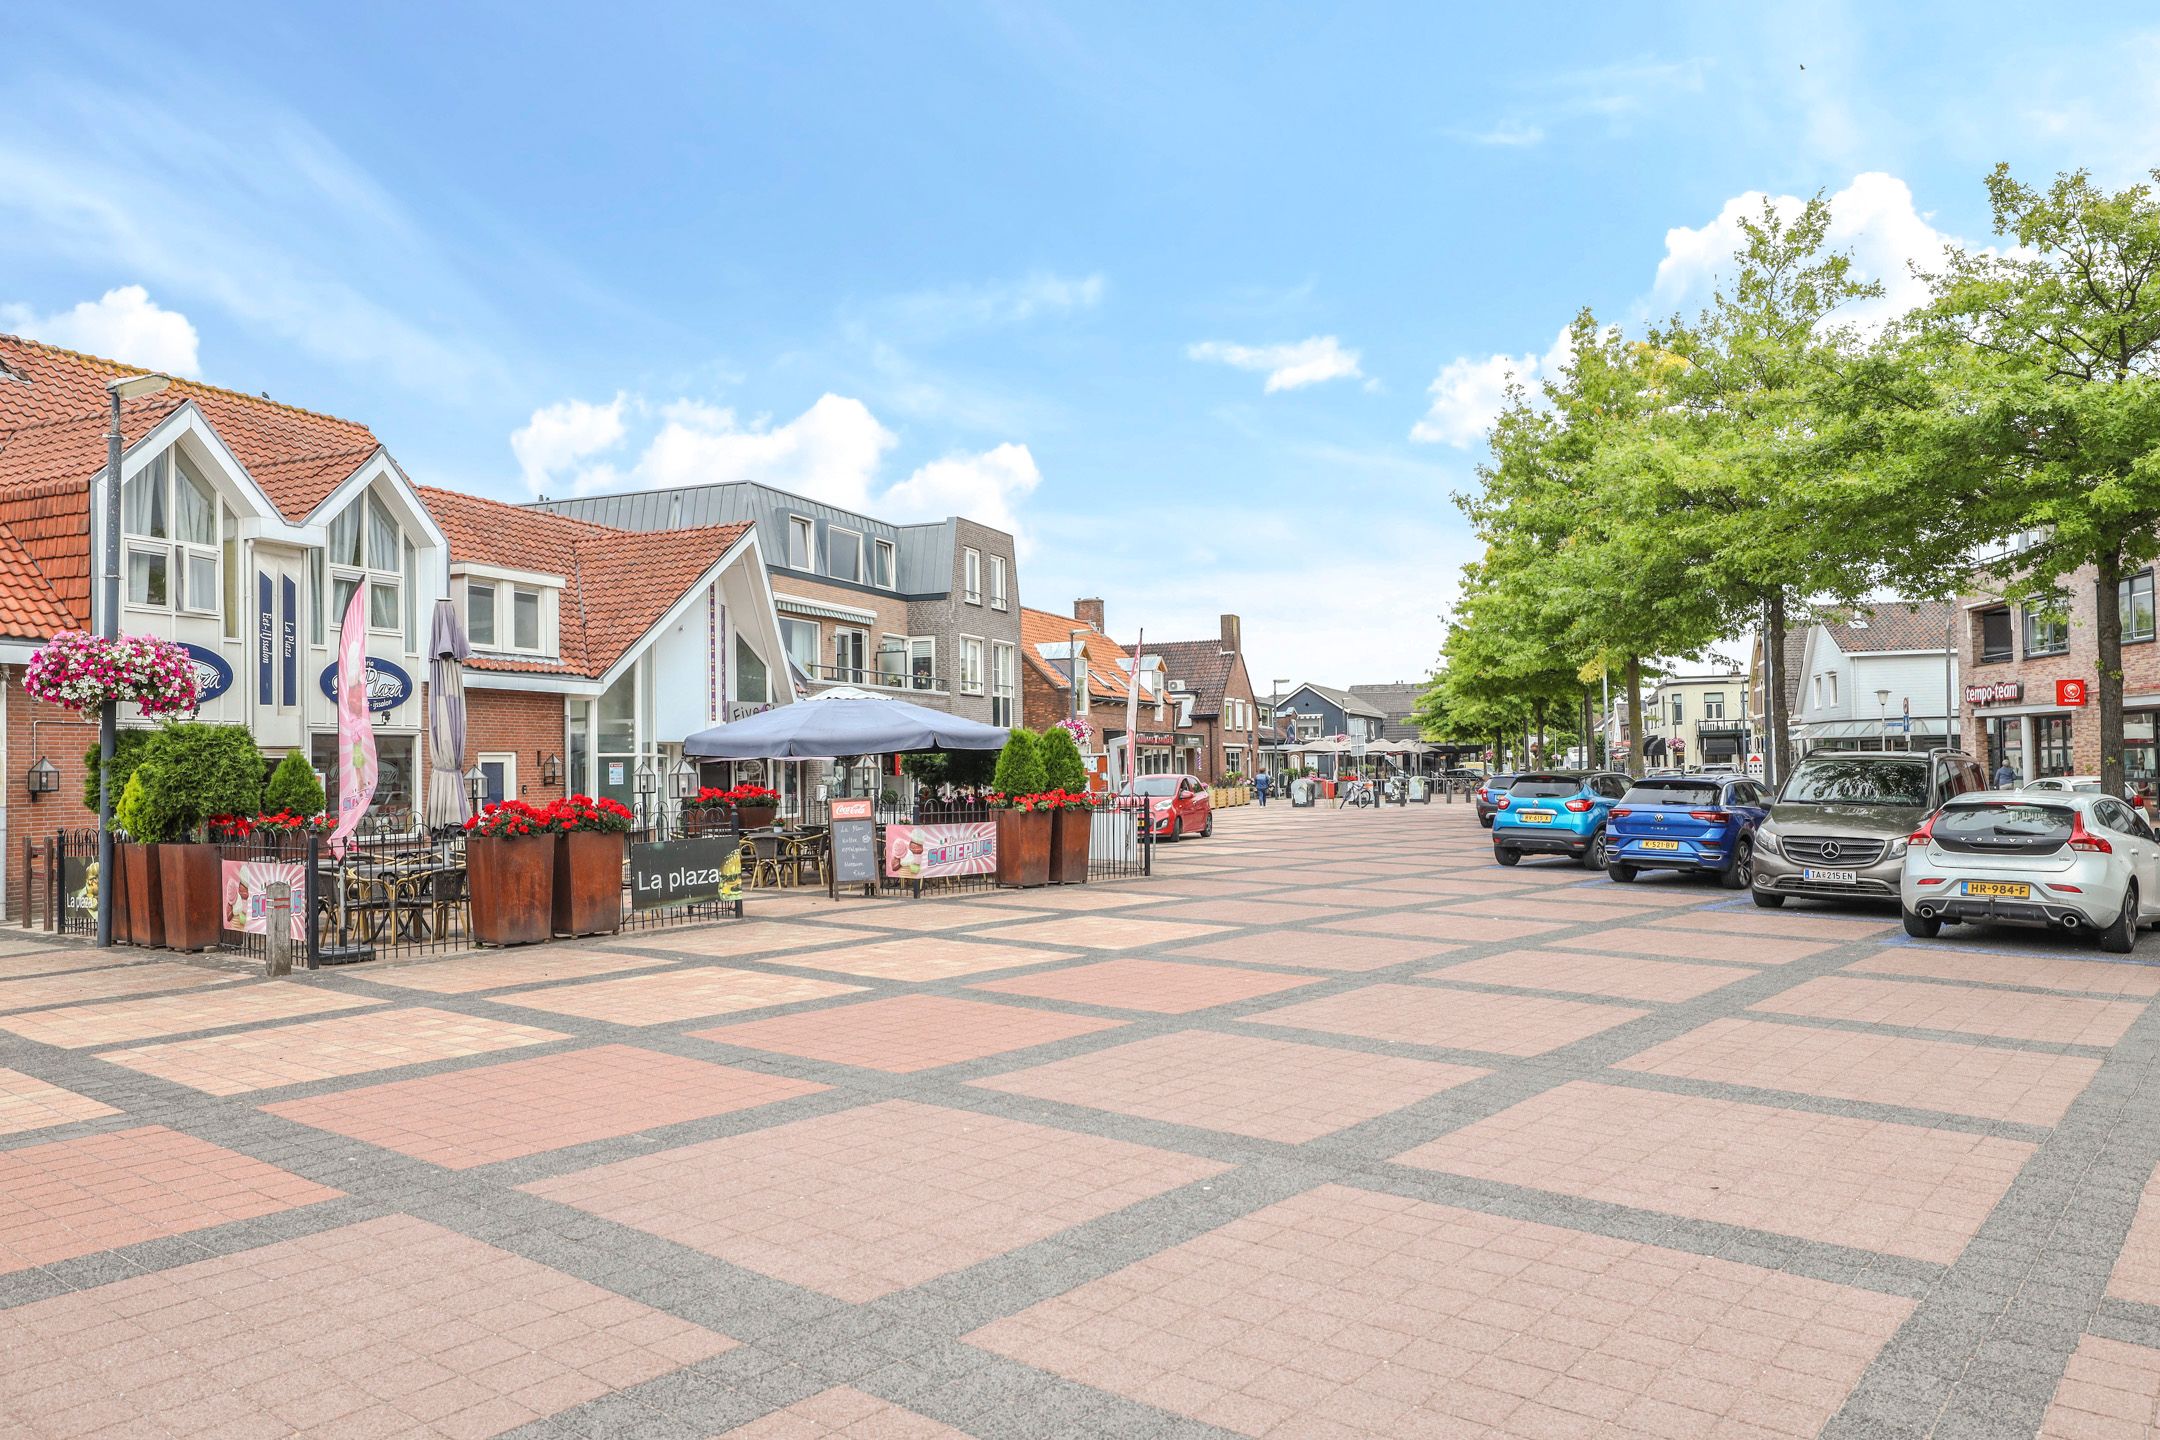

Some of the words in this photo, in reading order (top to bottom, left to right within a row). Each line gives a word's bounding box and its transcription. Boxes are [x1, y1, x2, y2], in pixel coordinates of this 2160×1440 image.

[284, 621, 295, 632] La
[284, 634, 295, 658] Plaza
[1960, 836, 2033, 844] VOLVO
[638, 871, 662, 891] La
[669, 866, 721, 893] plaza
[1971, 884, 2026, 895] HR-984-F
[66, 892, 75, 908] La
